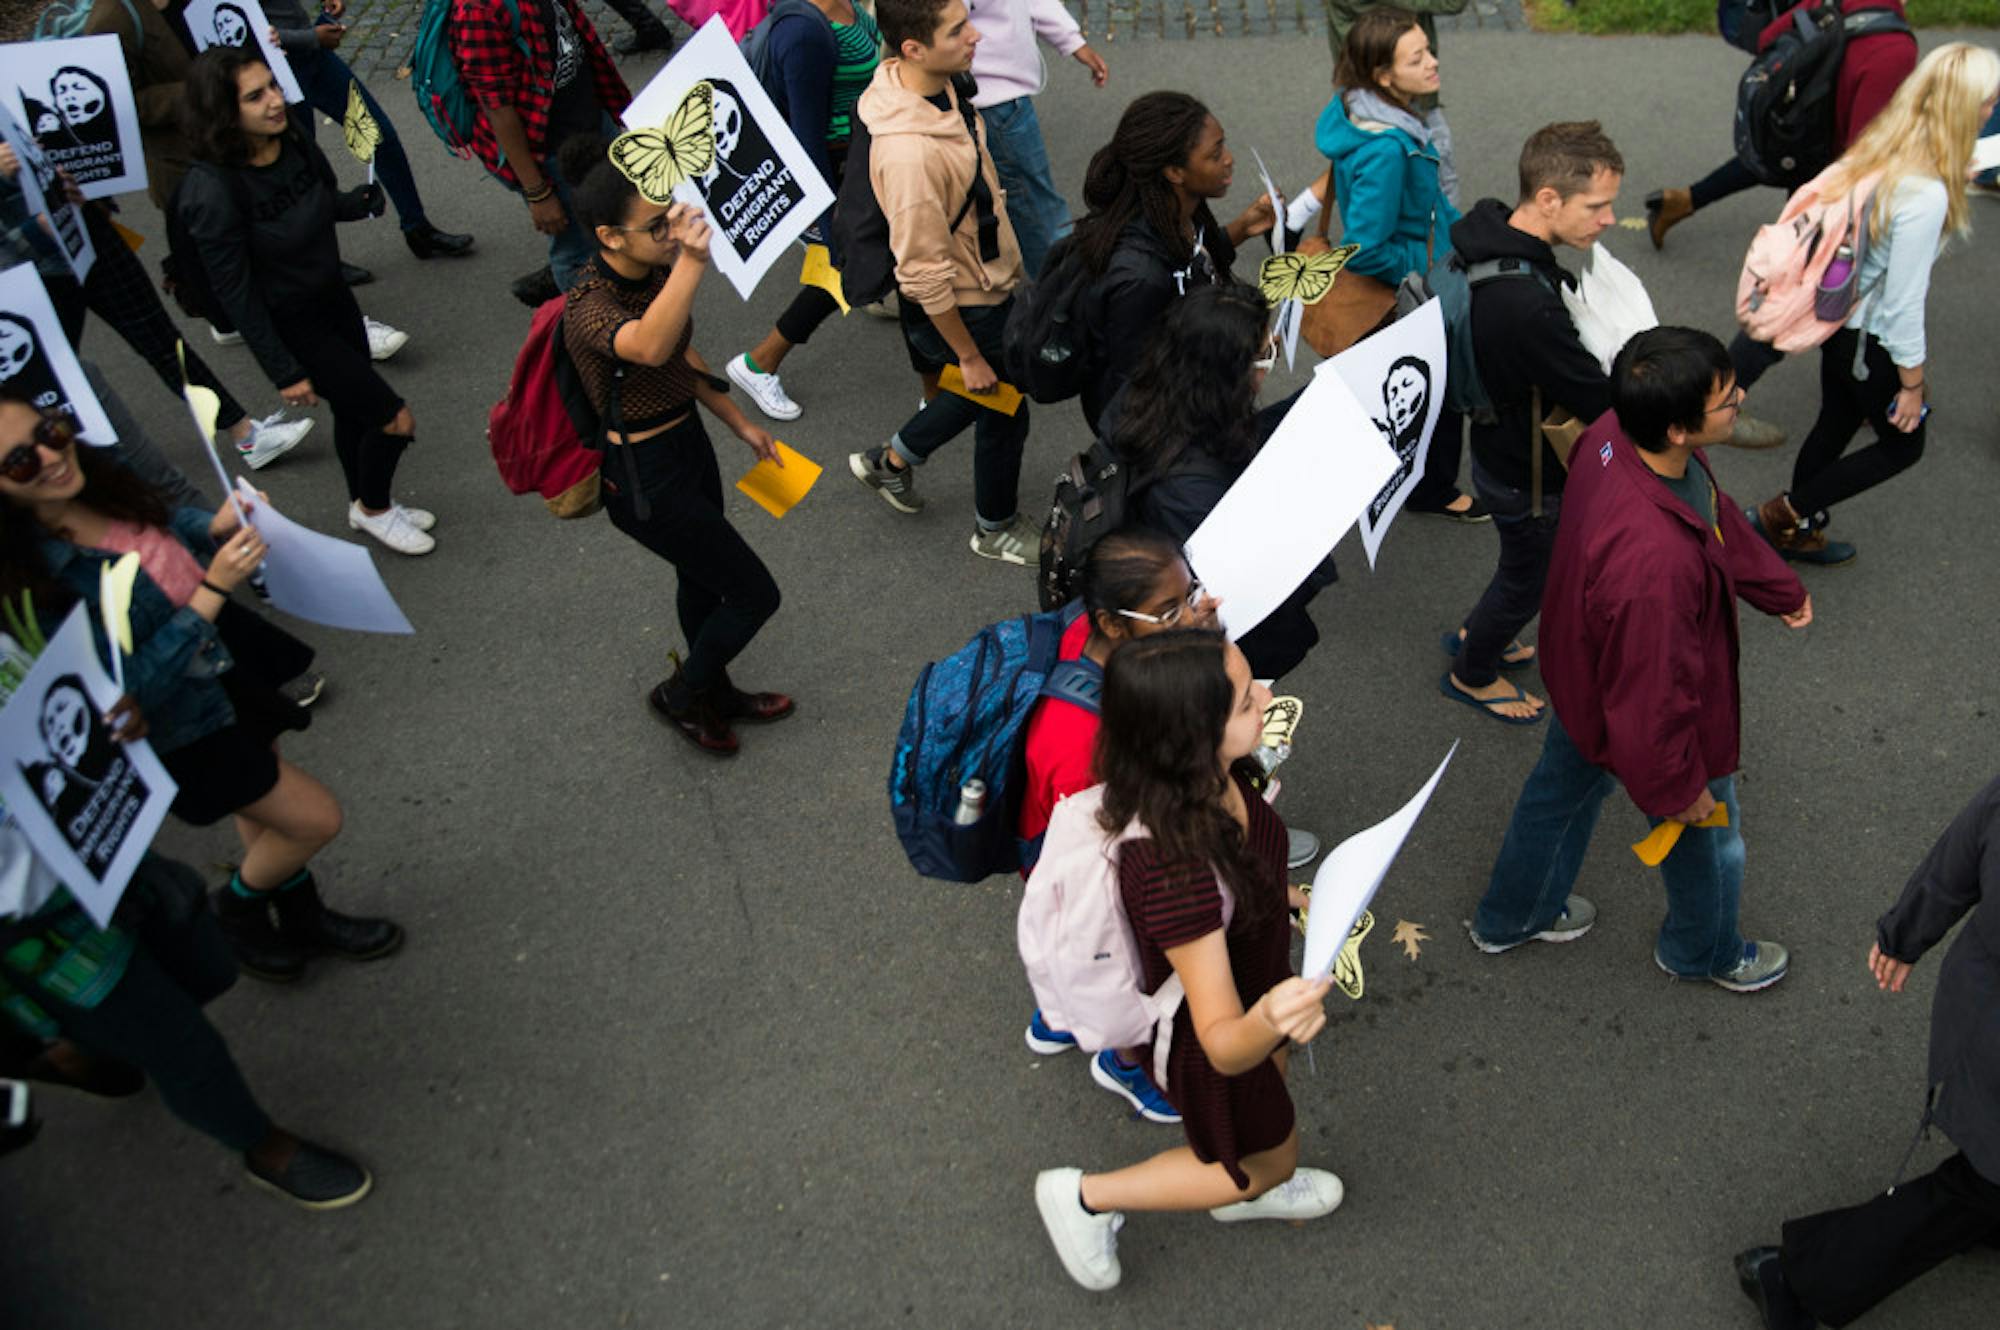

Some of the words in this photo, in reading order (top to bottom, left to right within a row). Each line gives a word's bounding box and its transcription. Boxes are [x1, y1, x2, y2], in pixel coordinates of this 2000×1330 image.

[46, 141, 113, 161] DEFEND
[720, 159, 776, 221] DEFEND
[725, 168, 792, 243] IMMIGRANT
[744, 194, 791, 246] RIGHTS
[69, 757, 124, 840] DEFEND
[97, 795, 139, 861] RIGHTS
